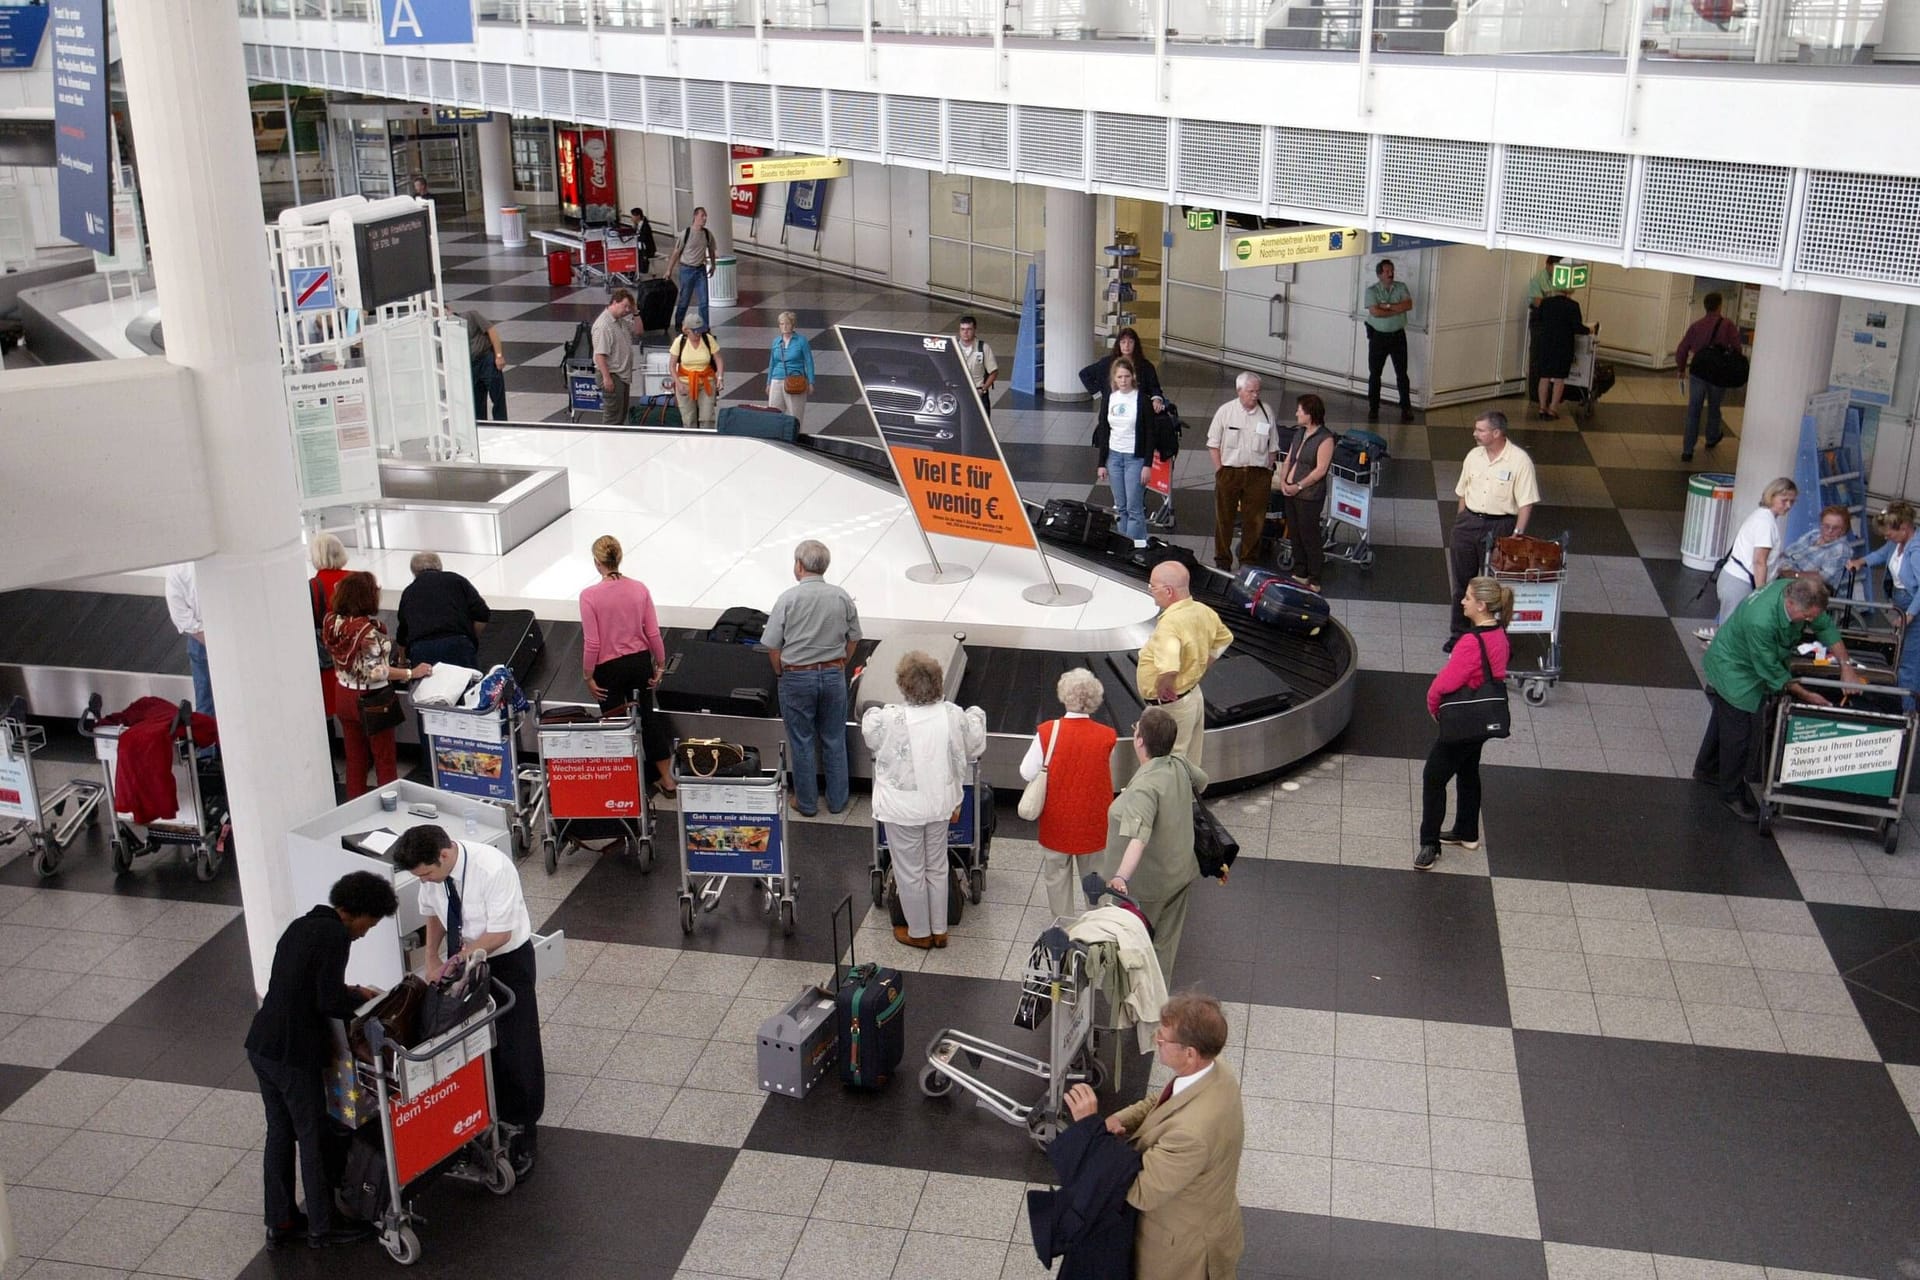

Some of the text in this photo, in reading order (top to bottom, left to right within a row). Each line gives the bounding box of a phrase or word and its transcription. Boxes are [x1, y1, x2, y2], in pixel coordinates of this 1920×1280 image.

[389, 0, 423, 37] A
[1305, 233, 1327, 242] Waren
[1260, 244, 1319, 259] Nothing to declare
[290, 384, 300, 392] Ihr
[302, 382, 316, 390] Weg
[318, 380, 336, 388] durch
[351, 376, 363, 385] Zoll
[913, 457, 992, 490] Viel E für
[926, 490, 1003, 520] wenig €.
[476, 742, 504, 751] shoppen.
[1831, 743, 1852, 751] Ihren
[1823, 754, 1832, 762] at
[1833, 753, 1853, 764] your
[552, 764, 585, 772] Wechsel
[613, 764, 632, 772] auch
[1827, 765, 1833, 774] à
[1834, 763, 1857, 773] votre
[595, 772, 612, 780] her?
[395, 1104, 421, 1127] dem
[423, 1082, 461, 1110] Strom.
